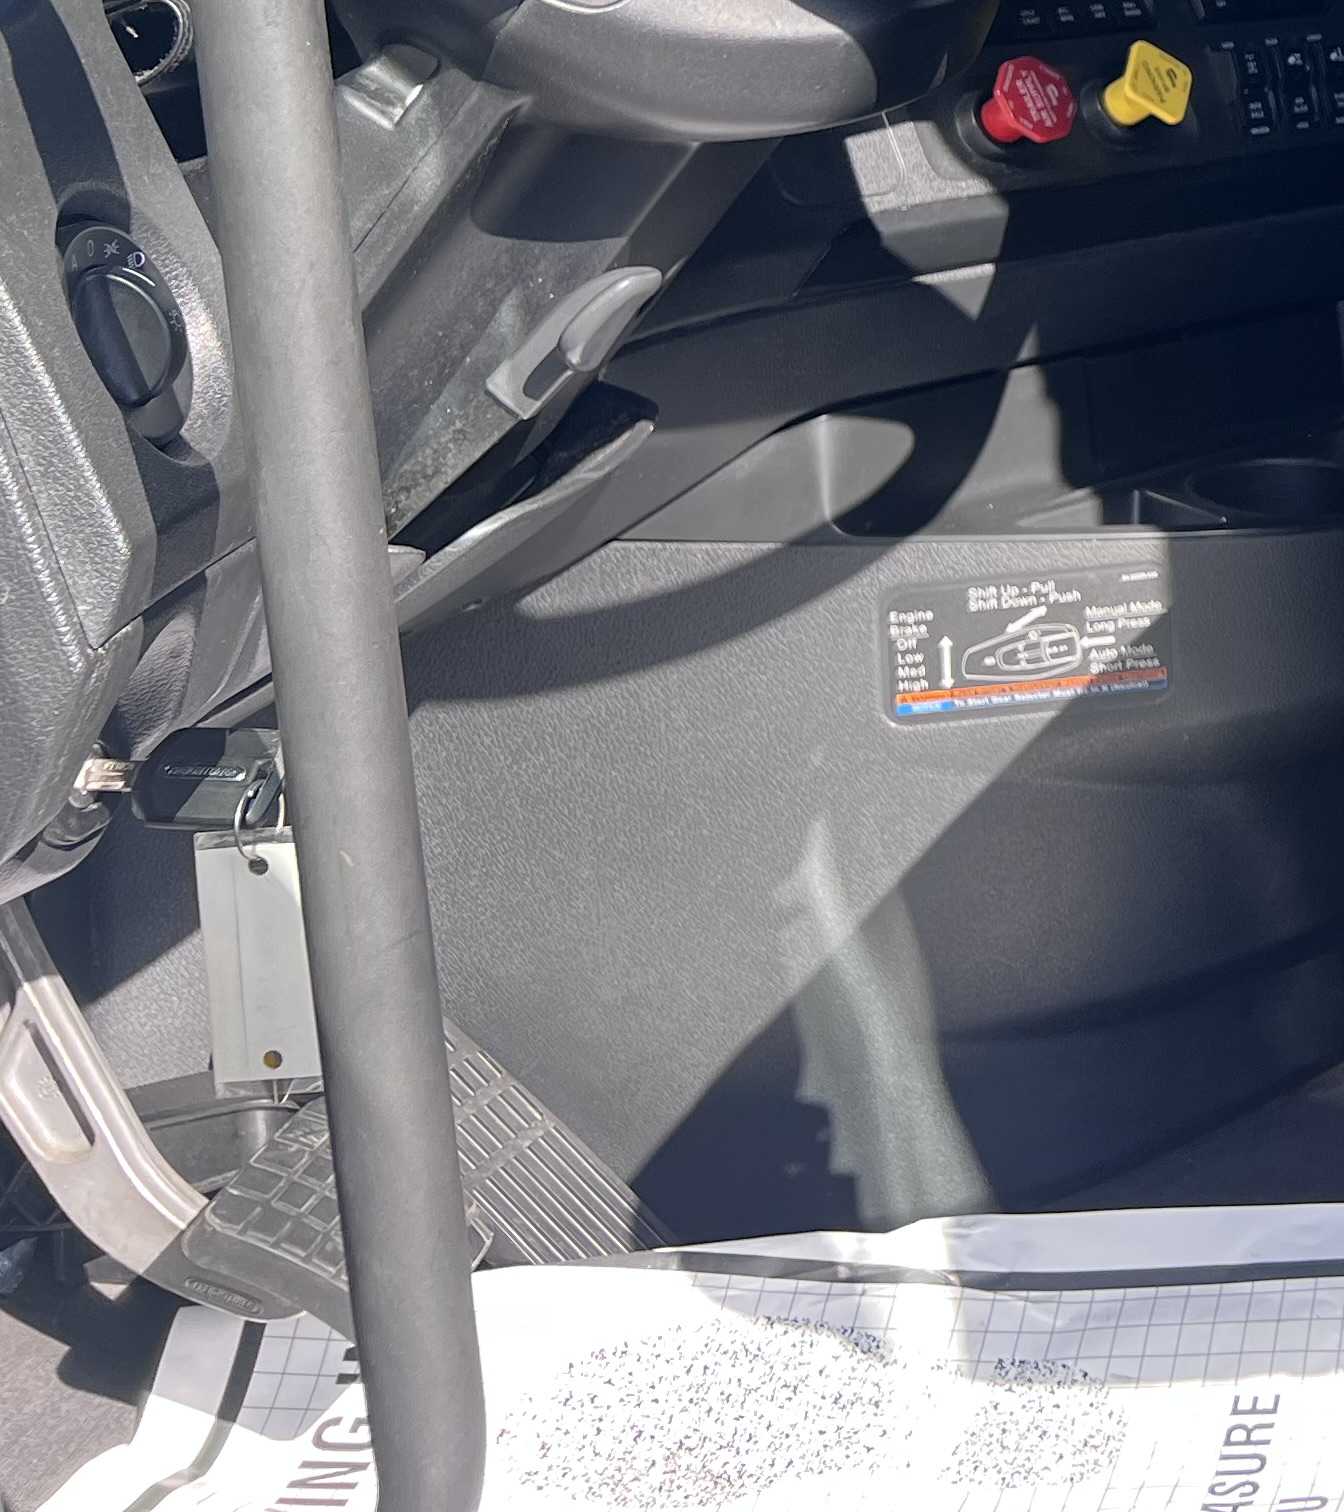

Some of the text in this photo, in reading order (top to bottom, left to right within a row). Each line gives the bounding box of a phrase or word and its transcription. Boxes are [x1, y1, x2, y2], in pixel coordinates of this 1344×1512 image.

[968, 586, 998, 599] Shift
[1001, 584, 1019, 597] Up
[1031, 580, 1055, 594] Pull
[968, 597, 998, 612] Shift
[1001, 596, 1037, 609] Down
[1049, 589, 1081, 603] Push
[1084, 600, 1162, 618] Manual Mode
[890, 610, 934, 624] Engine
[890, 624, 928, 636] Brake
[1086, 617, 1150, 633] Long Press
[896, 638, 917, 651] Off
[897, 653, 924, 665] Low
[1089, 648, 1118, 660] Auto
[898, 664, 926, 678] Med
[1089, 658, 1160, 674] Short Press
[898, 678, 929, 692] High
[264, 1415, 373, 1512] ING
